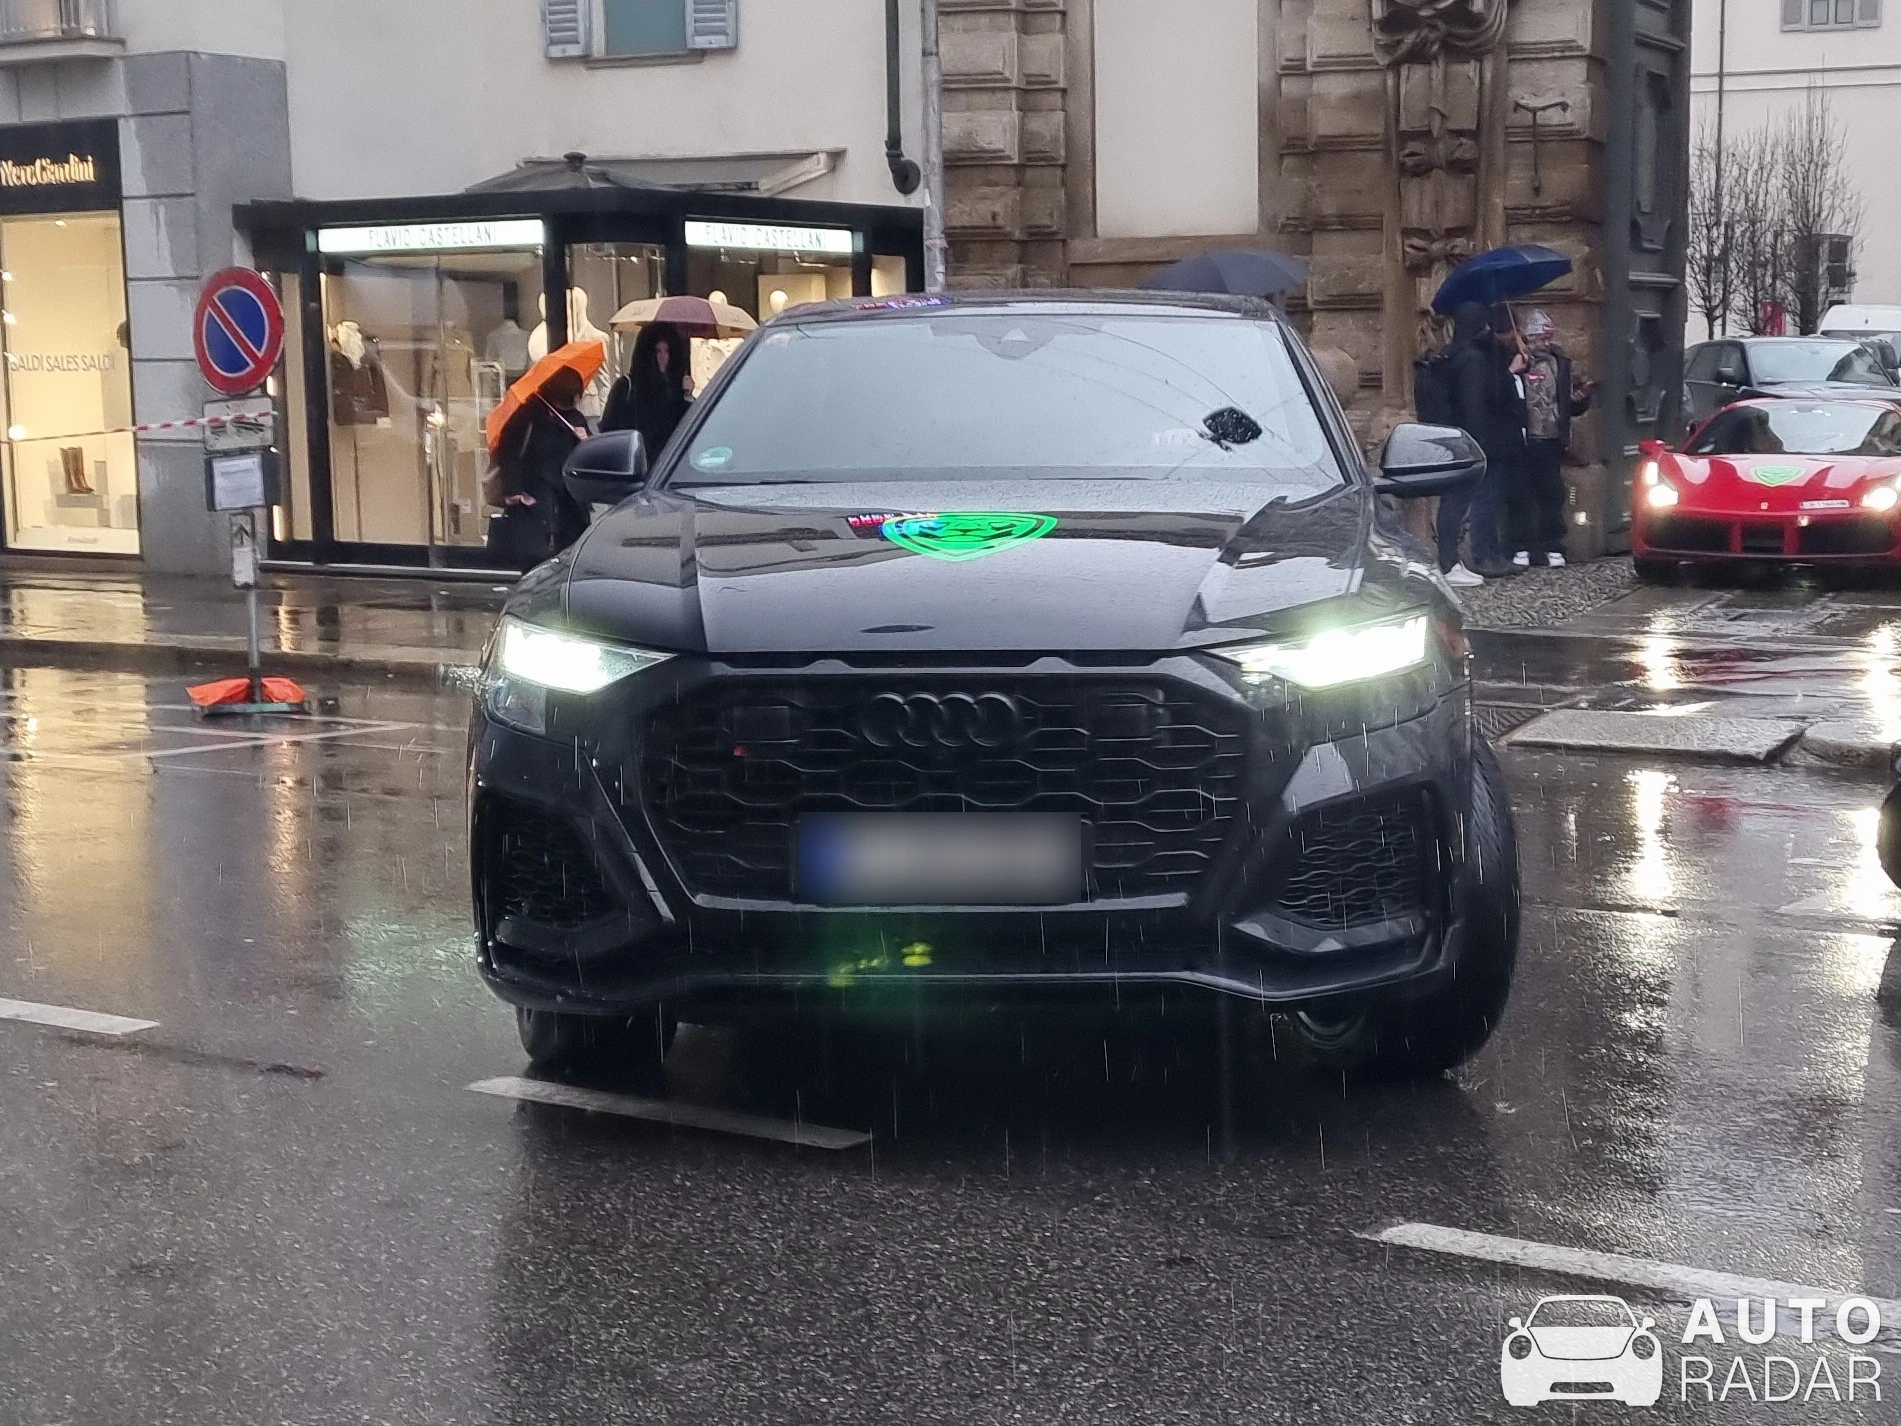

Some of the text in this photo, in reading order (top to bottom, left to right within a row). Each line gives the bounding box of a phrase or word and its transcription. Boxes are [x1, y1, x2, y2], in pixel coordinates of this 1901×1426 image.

[368, 225, 497, 249] FLAVIO CASTELLANI
[705, 224, 747, 245] FLAVIO
[46, 354, 79, 372] SALES
